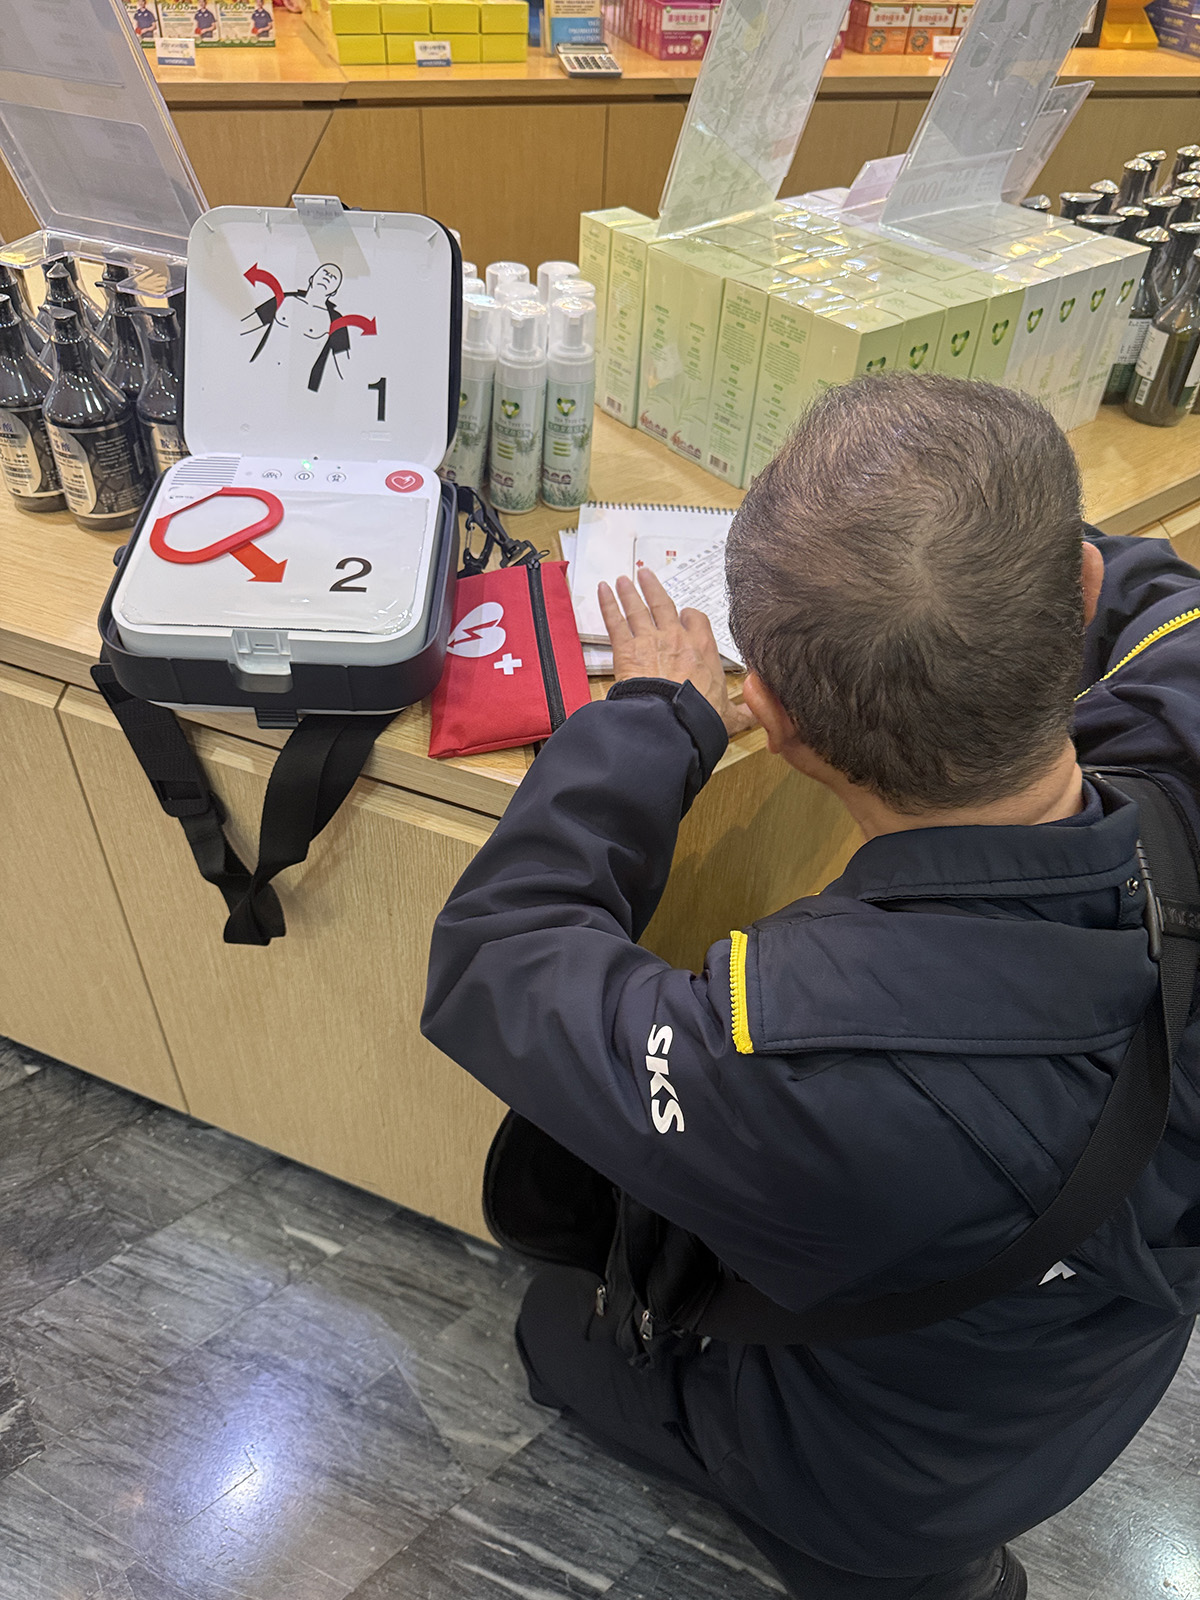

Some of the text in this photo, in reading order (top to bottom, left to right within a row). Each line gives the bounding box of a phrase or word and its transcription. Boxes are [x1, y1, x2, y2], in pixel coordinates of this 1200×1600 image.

[367, 376, 387, 422] 1
[329, 556, 373, 593] 2
[645, 1023, 685, 1134] SKS
